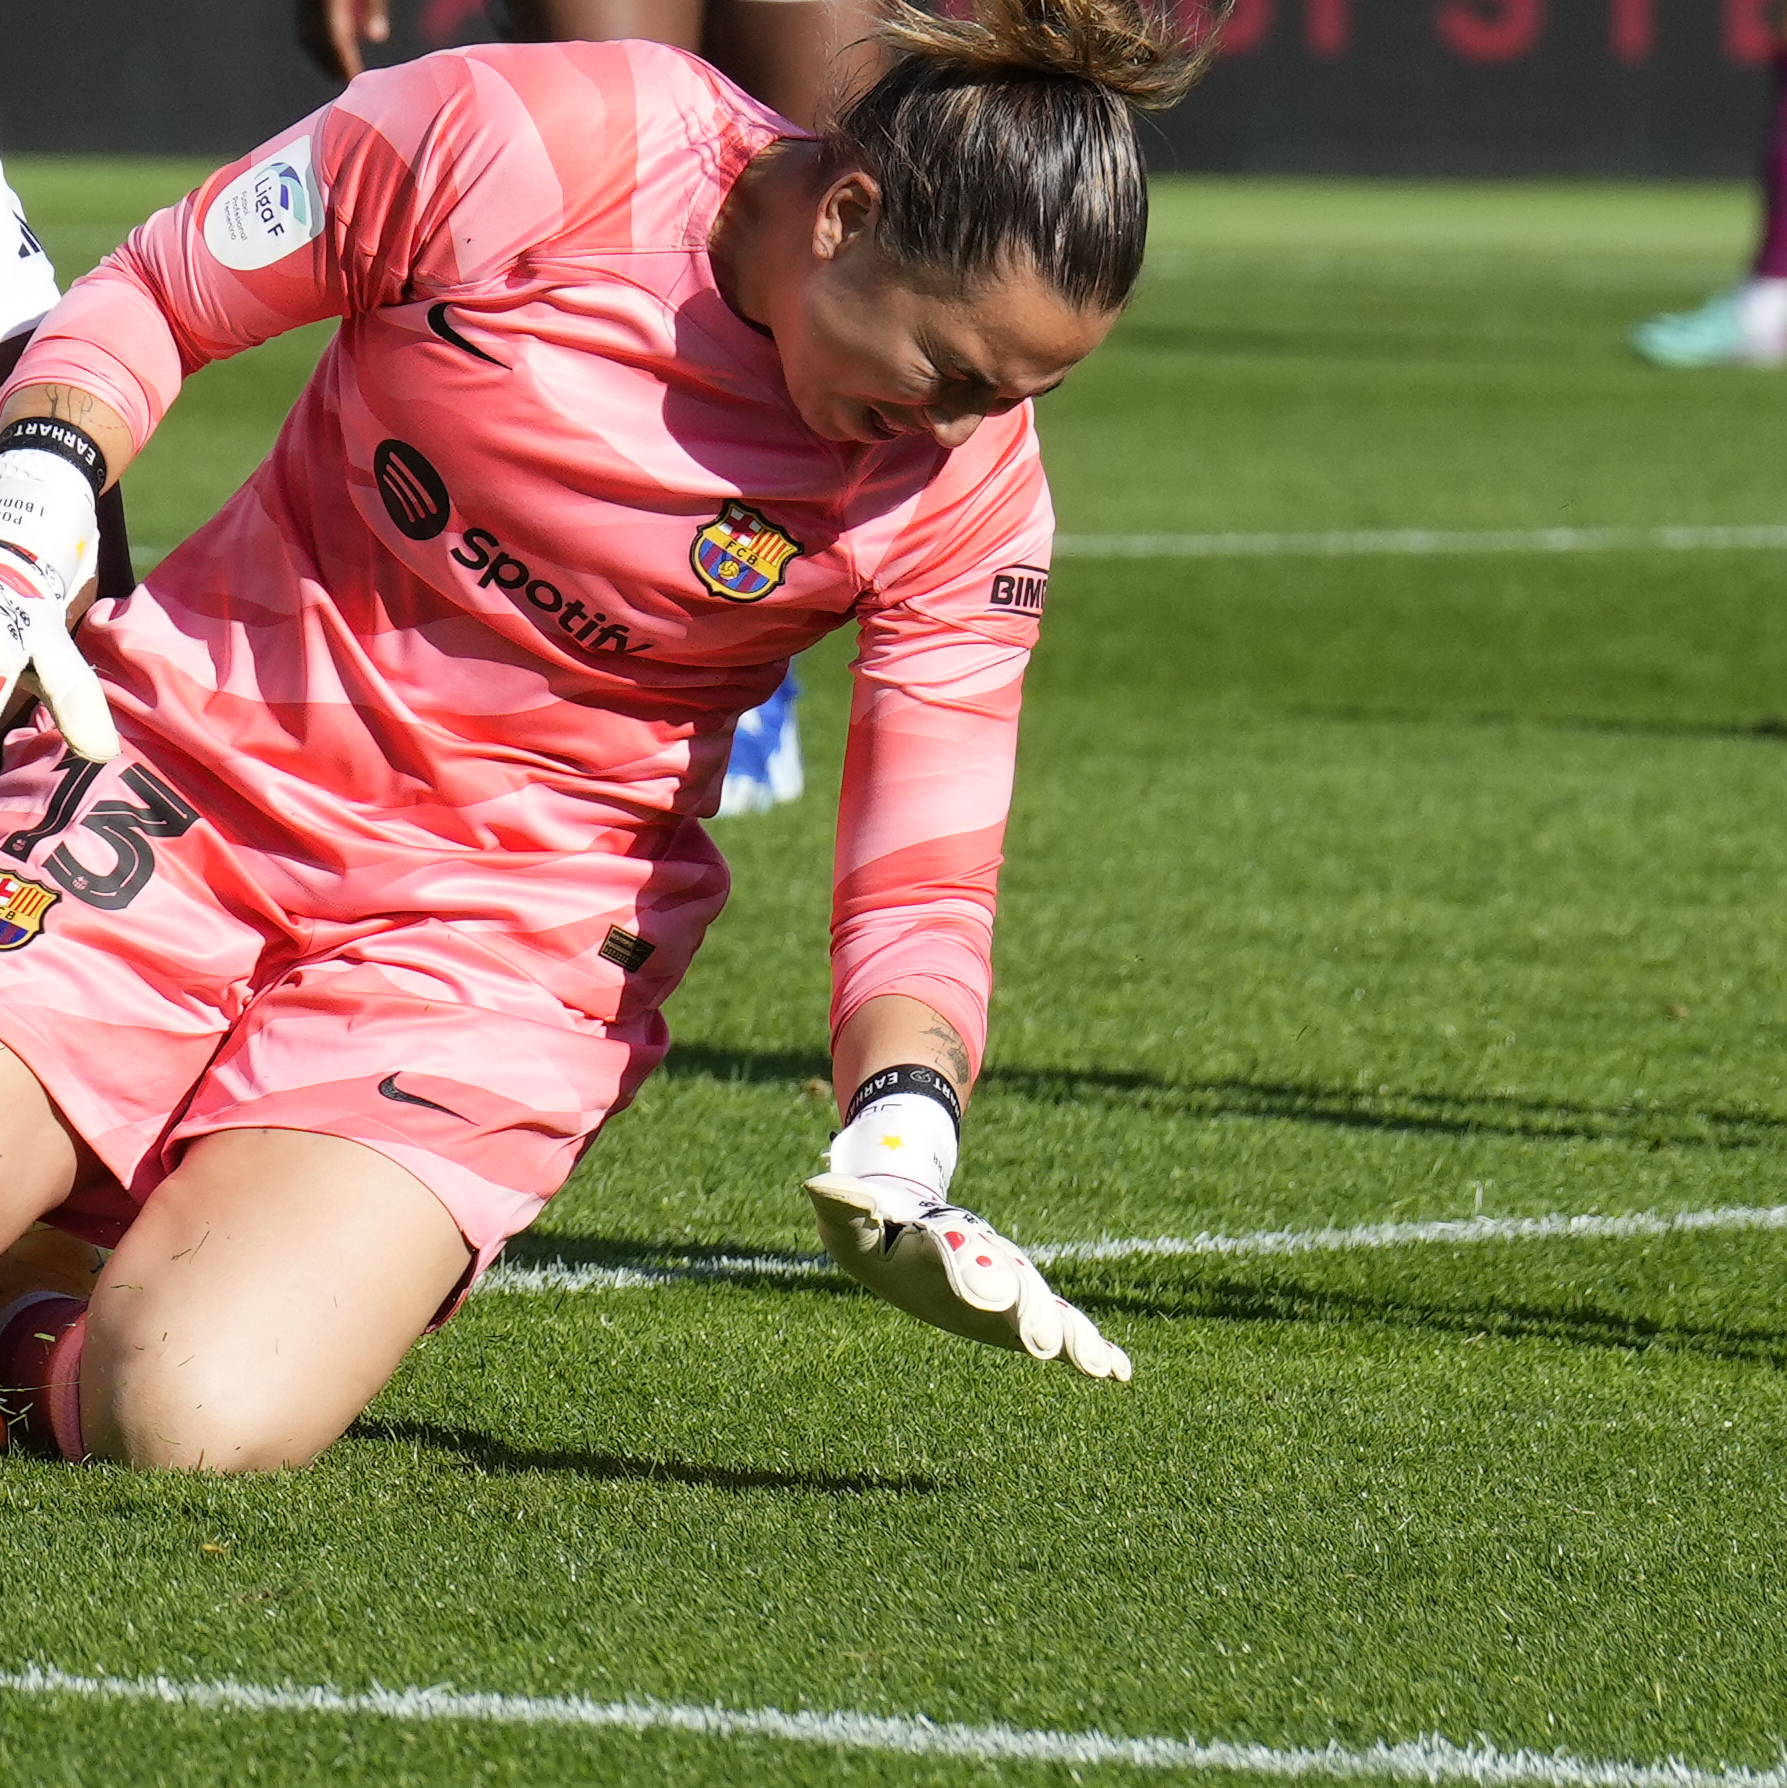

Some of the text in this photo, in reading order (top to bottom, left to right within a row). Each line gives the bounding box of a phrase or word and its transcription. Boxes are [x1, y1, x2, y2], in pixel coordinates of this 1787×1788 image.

[254, 176, 285, 237] Liga F
[13, 422, 97, 467] EARHART
[725, 538, 759, 567] FCB
[450, 527, 654, 653] Spotify
[1, 750, 201, 911] 13
